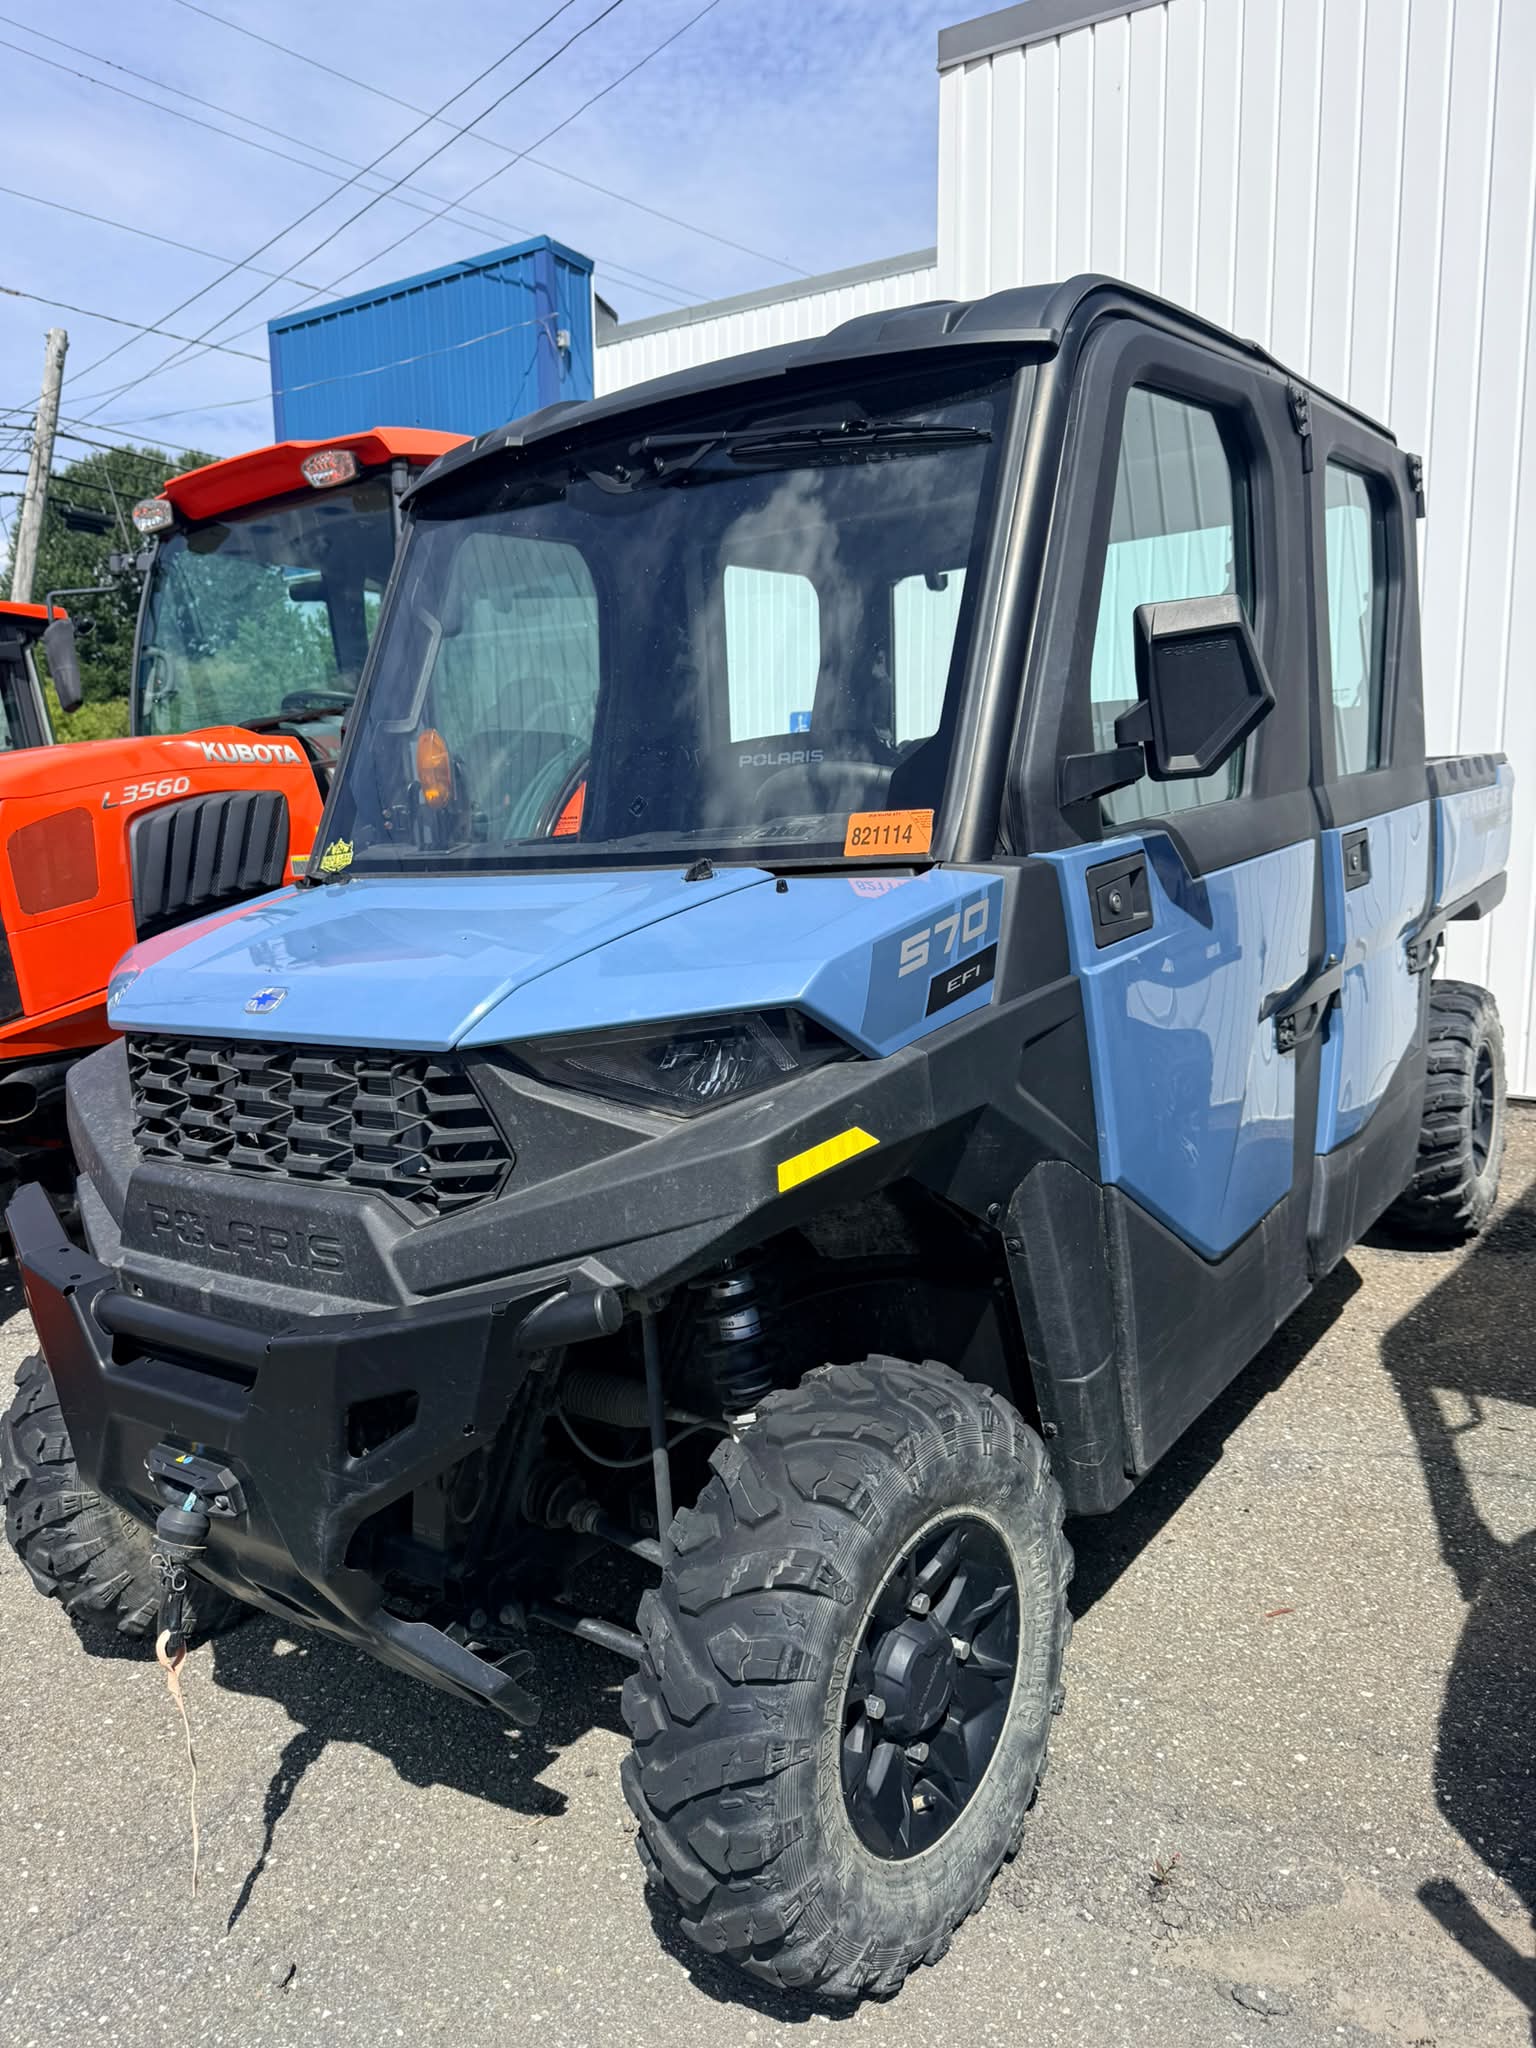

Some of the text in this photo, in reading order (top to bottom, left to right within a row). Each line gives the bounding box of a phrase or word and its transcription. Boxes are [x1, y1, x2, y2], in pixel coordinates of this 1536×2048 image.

[200, 741, 302, 764] KUBOTA
[739, 749, 825, 768] POLARIS
[102, 776, 190, 809] L3560
[851, 824, 912, 846] 821114
[898, 898, 989, 978] 570
[947, 964, 980, 993] EFI
[146, 1202, 345, 1275] POLARIS
